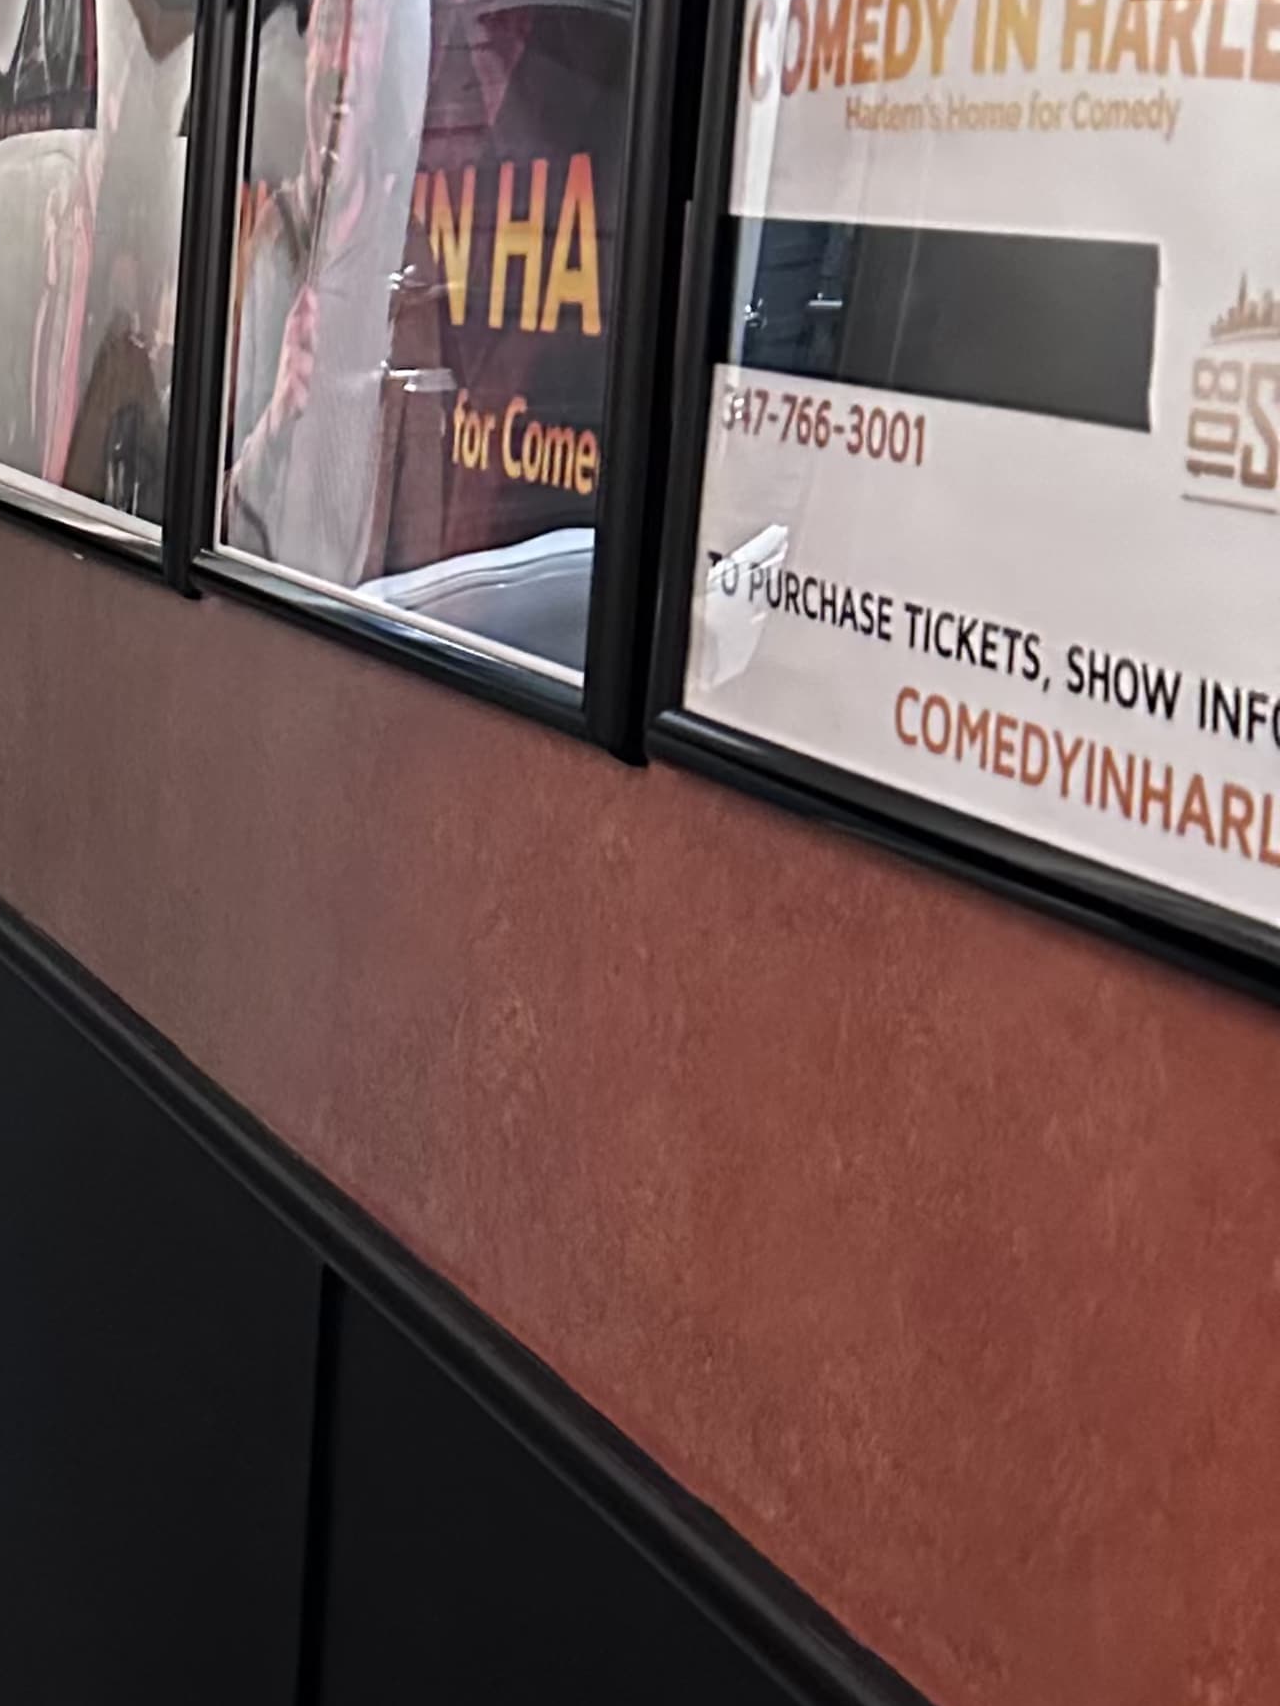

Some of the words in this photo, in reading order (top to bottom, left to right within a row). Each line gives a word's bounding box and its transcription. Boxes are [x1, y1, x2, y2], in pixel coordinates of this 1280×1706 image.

[845, 93, 940, 132] Harlem's
[946, 94, 1025, 132] Home
[1027, 90, 1066, 131] for
[1071, 87, 1183, 143] Comedy
[488, 152, 603, 337] HA
[451, 388, 497, 472] for
[501, 395, 602, 496] Come
[748, 559, 894, 643] PURCHASE
[904, 601, 1051, 694] TICKETS,
[1066, 645, 1183, 721] SHOW
